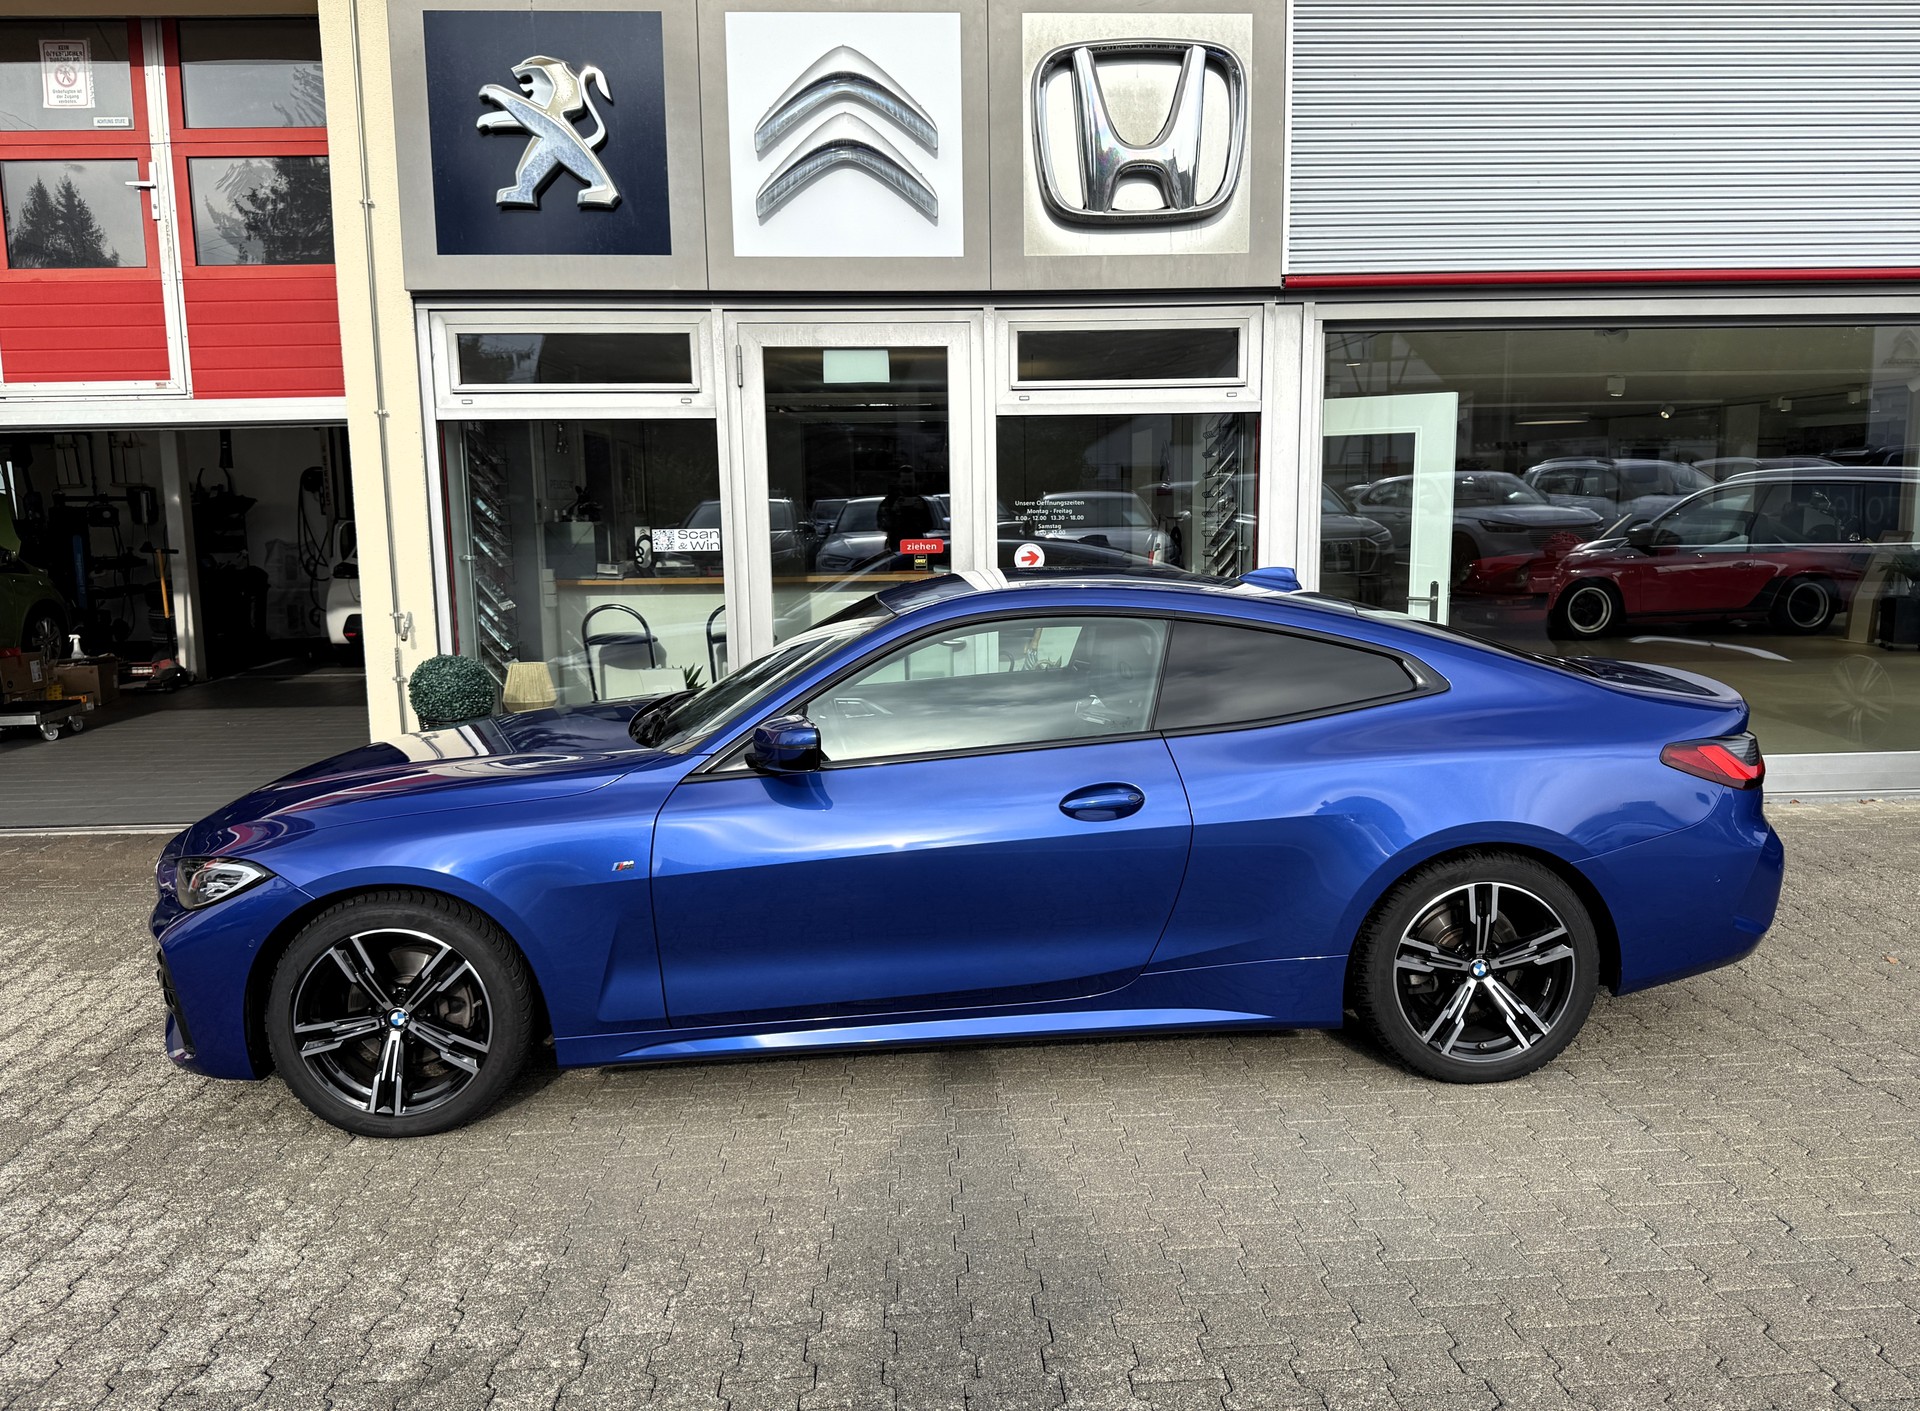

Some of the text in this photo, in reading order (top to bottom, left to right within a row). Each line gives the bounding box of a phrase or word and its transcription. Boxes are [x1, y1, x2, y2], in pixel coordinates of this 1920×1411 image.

[677, 529, 719, 540] Scan
[678, 539, 720, 550] & Win
[907, 542, 937, 551] ziehen
